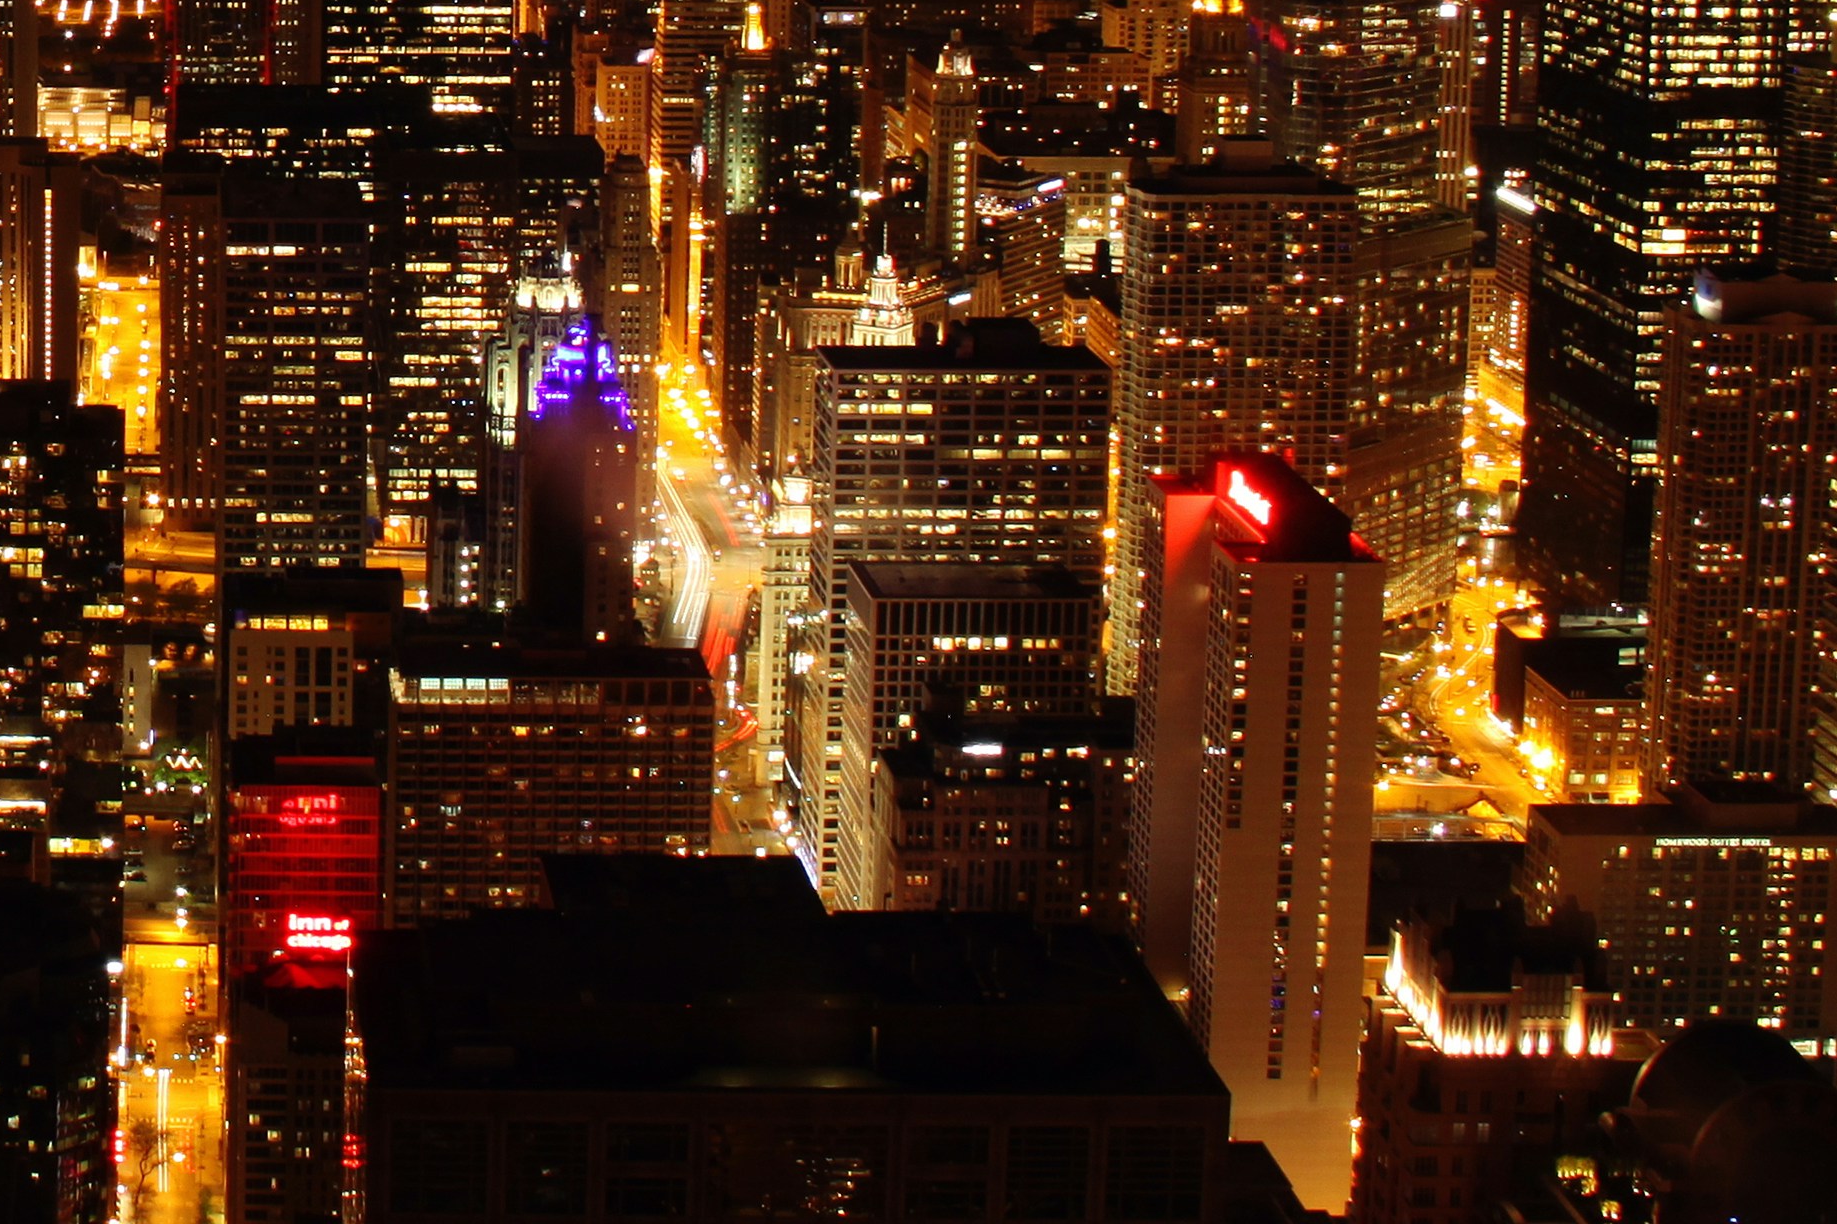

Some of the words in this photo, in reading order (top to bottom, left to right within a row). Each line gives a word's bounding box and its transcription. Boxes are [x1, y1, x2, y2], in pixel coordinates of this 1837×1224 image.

[288, 913, 332, 931] inn
[333, 919, 350, 931] of
[286, 933, 352, 951] chicago
